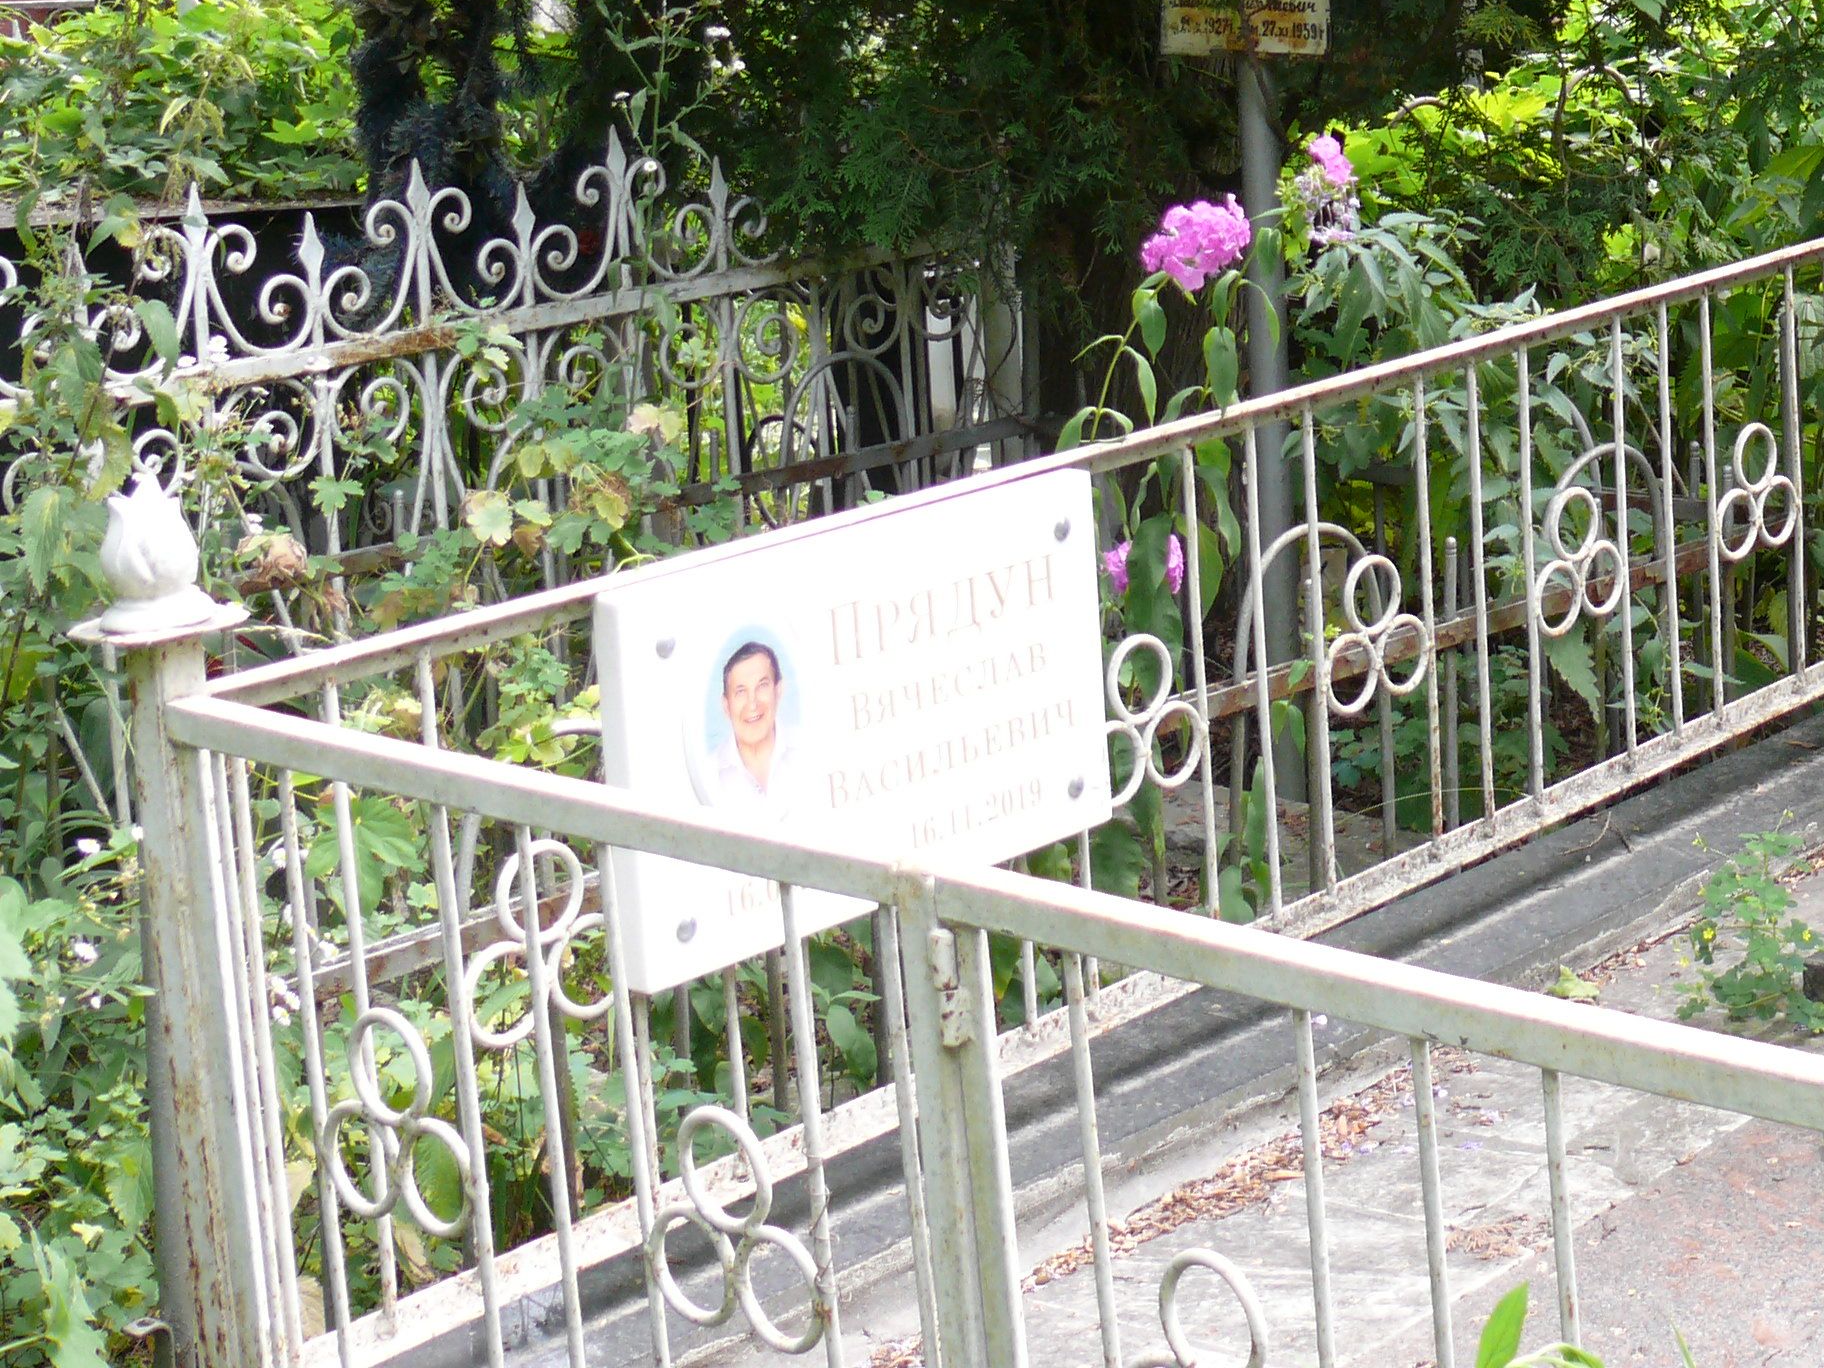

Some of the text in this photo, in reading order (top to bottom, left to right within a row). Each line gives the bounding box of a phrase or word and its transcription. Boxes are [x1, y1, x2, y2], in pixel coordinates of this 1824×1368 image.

[827, 553, 1057, 666] ПРЯДУН
[850, 642, 1049, 731] ВЯЧЕСЛАВ
[827, 697, 1078, 809] ВАСИЛЬЕВИЧ
